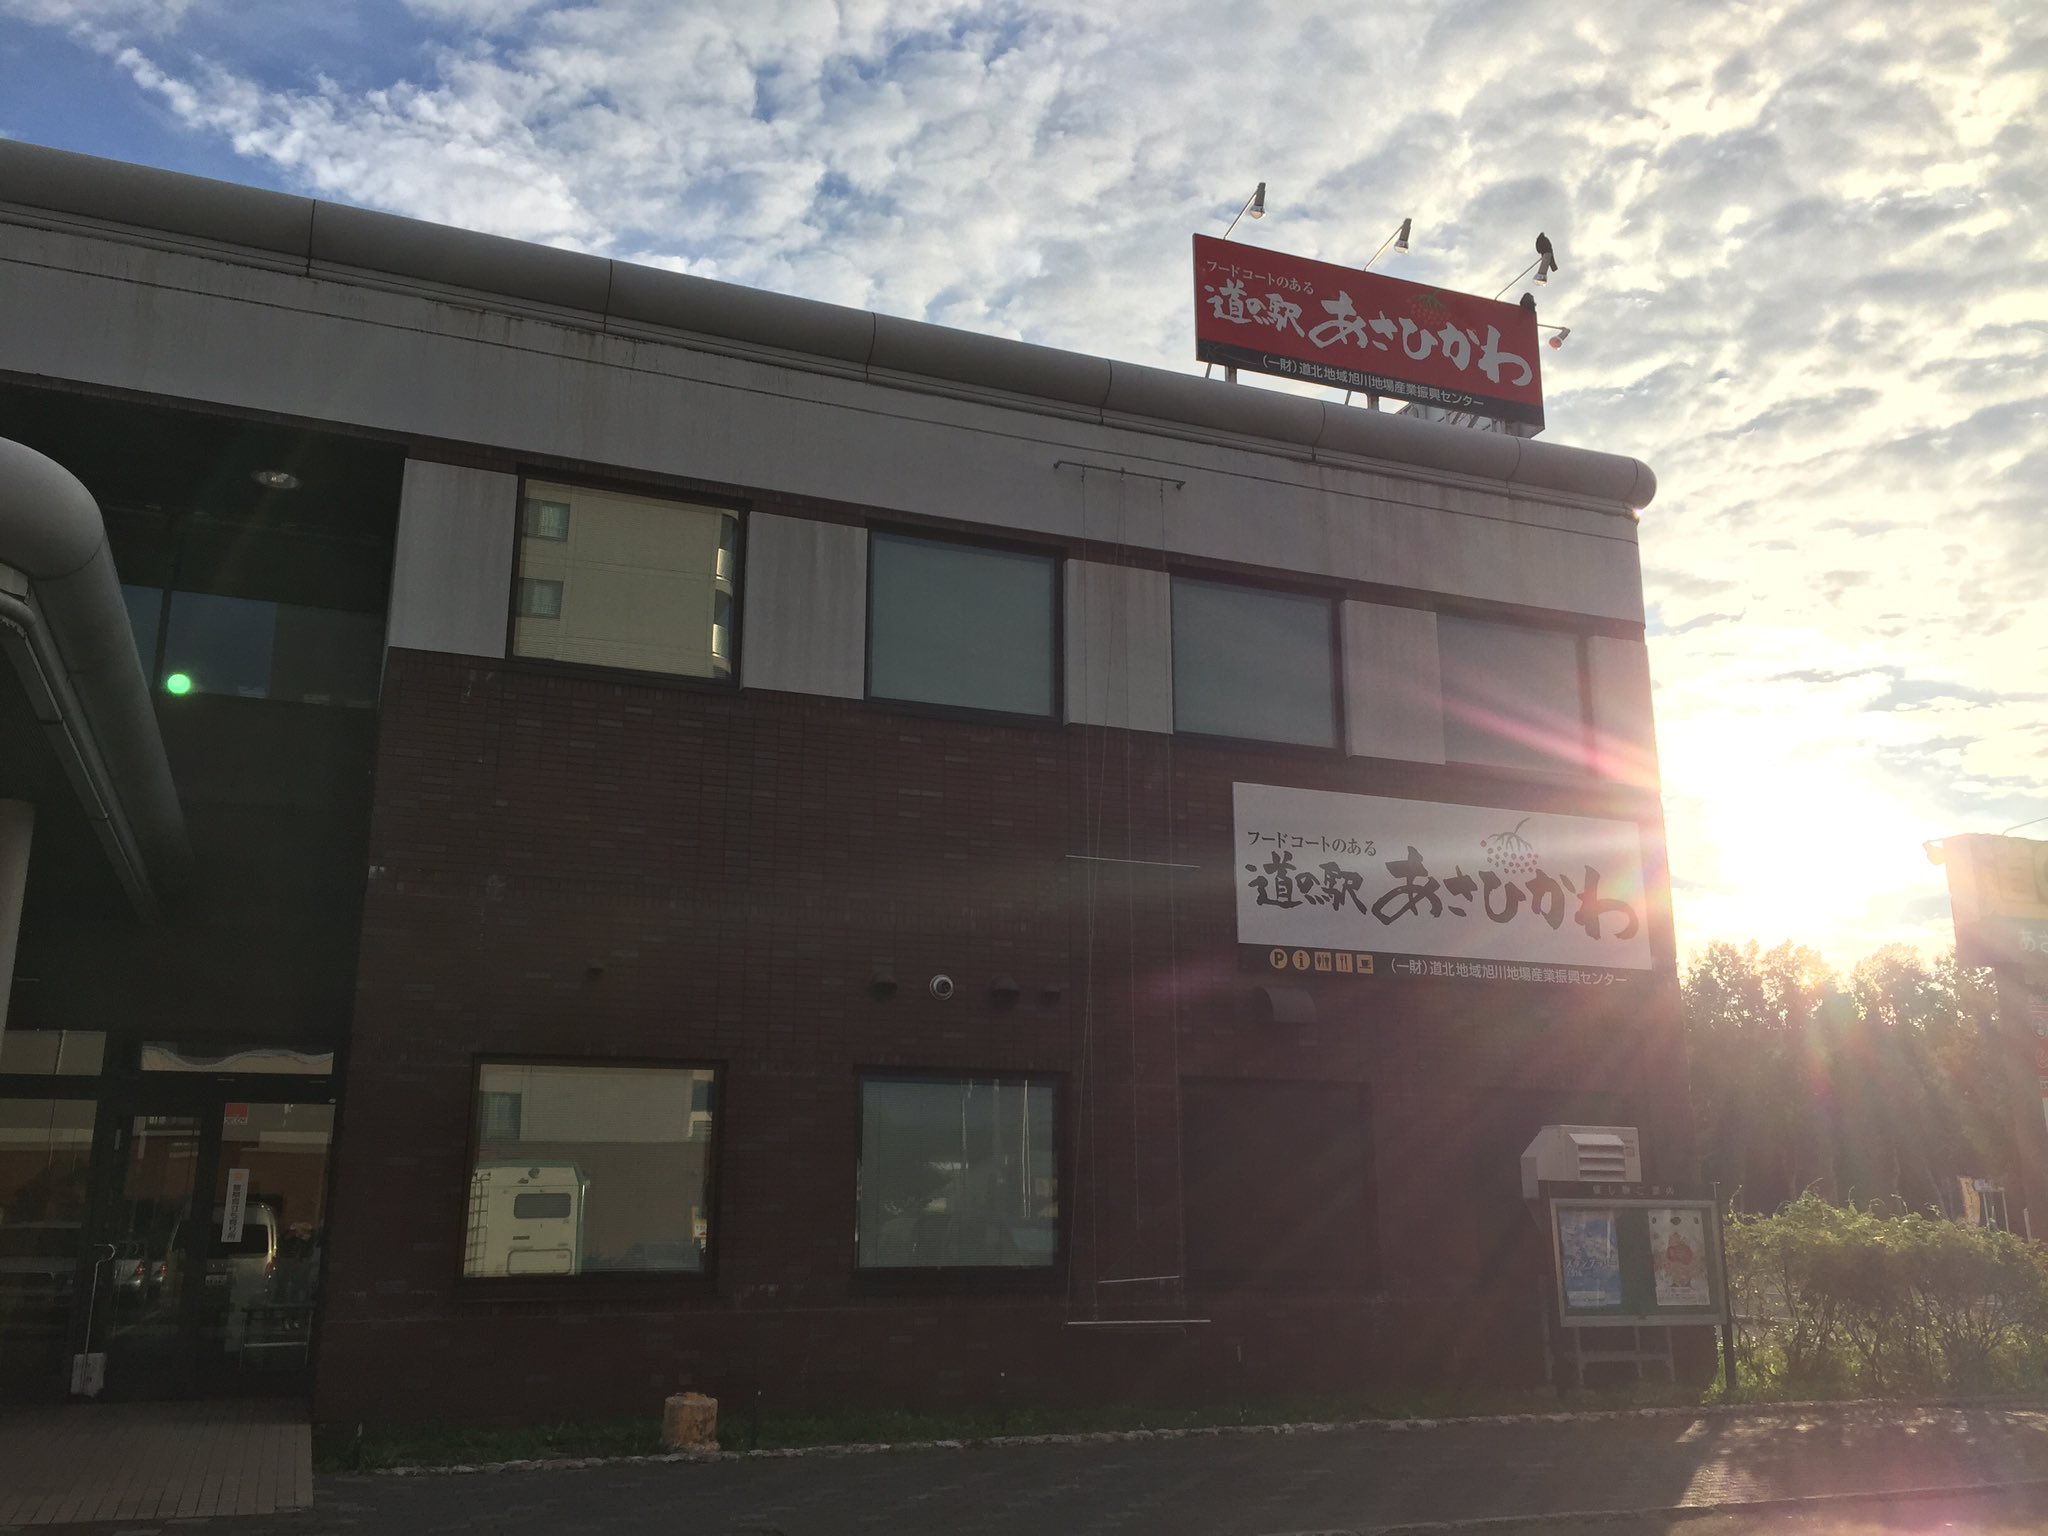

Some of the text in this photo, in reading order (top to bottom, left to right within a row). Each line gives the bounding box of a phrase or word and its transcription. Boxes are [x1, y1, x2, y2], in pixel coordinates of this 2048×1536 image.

[1206, 261, 1315, 295] フードコートのある
[1247, 831, 1377, 857] フードコートのある
